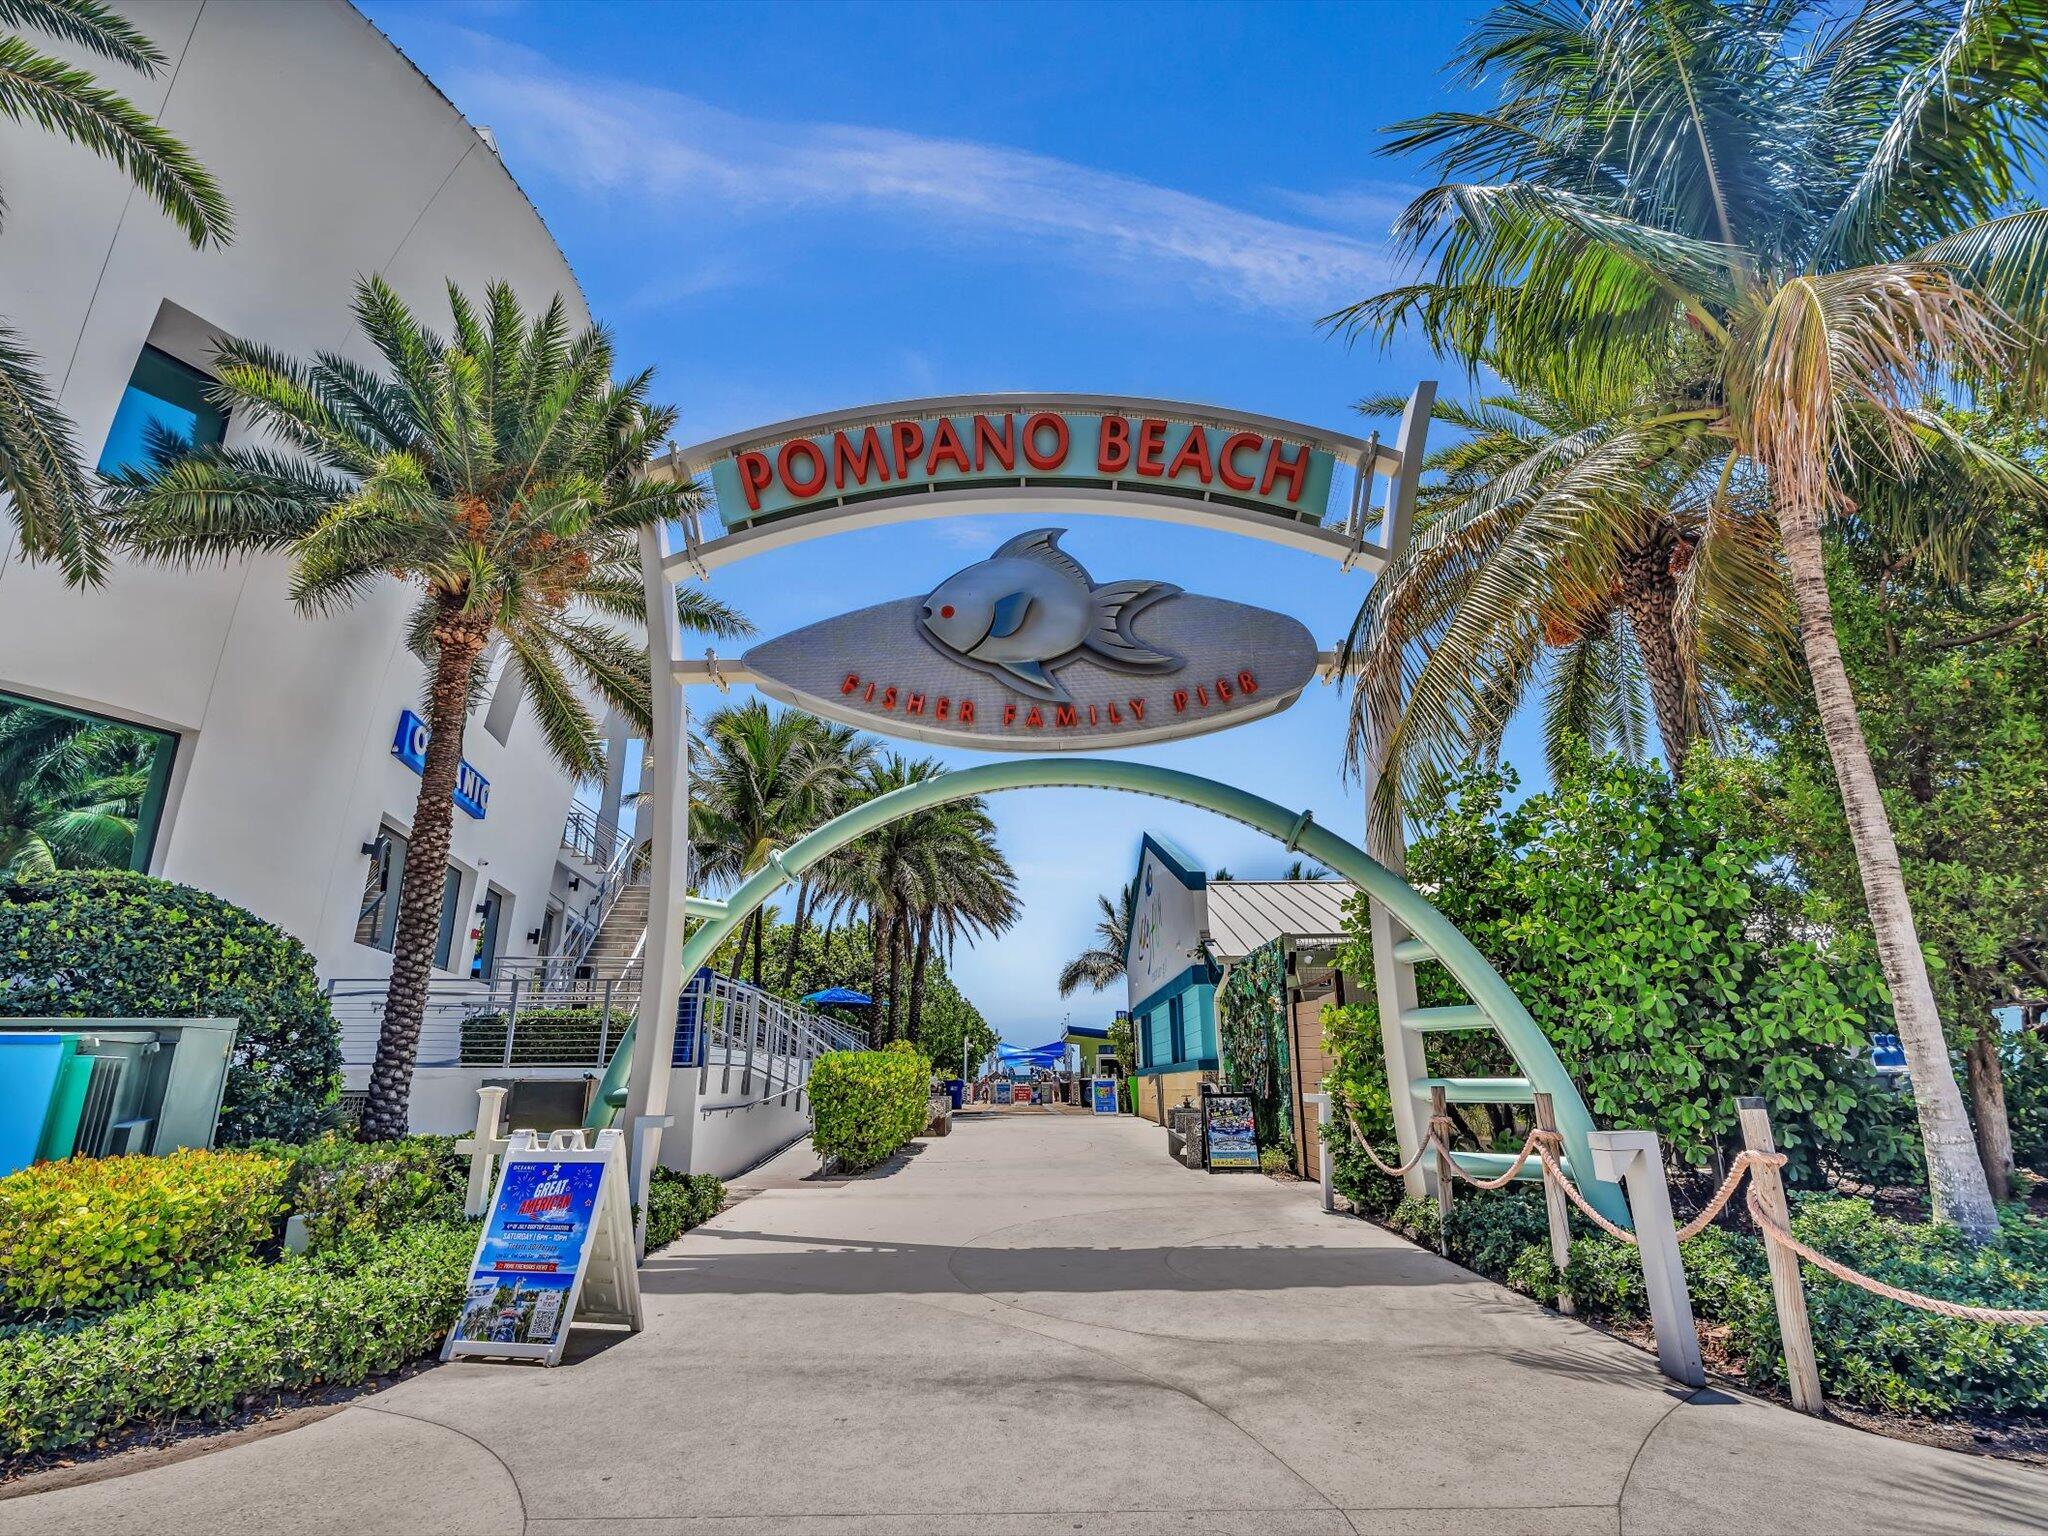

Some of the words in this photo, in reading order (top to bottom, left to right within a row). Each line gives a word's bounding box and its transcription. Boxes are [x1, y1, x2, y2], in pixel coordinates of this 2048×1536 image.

[736, 412, 1070, 511] POMPANO
[1097, 415, 1311, 503] BEACH
[840, 673, 975, 725] FISHER
[1003, 698, 1148, 728] FAMILY
[1172, 671, 1259, 713] PIER
[414, 725, 490, 809] ONIC
[517, 1194, 573, 1215] AMERICAN
[534, 1179, 569, 1198] GREAT
[503, 1232, 533, 1240] SATURDAY
[536, 1233, 549, 1241] 6PM
